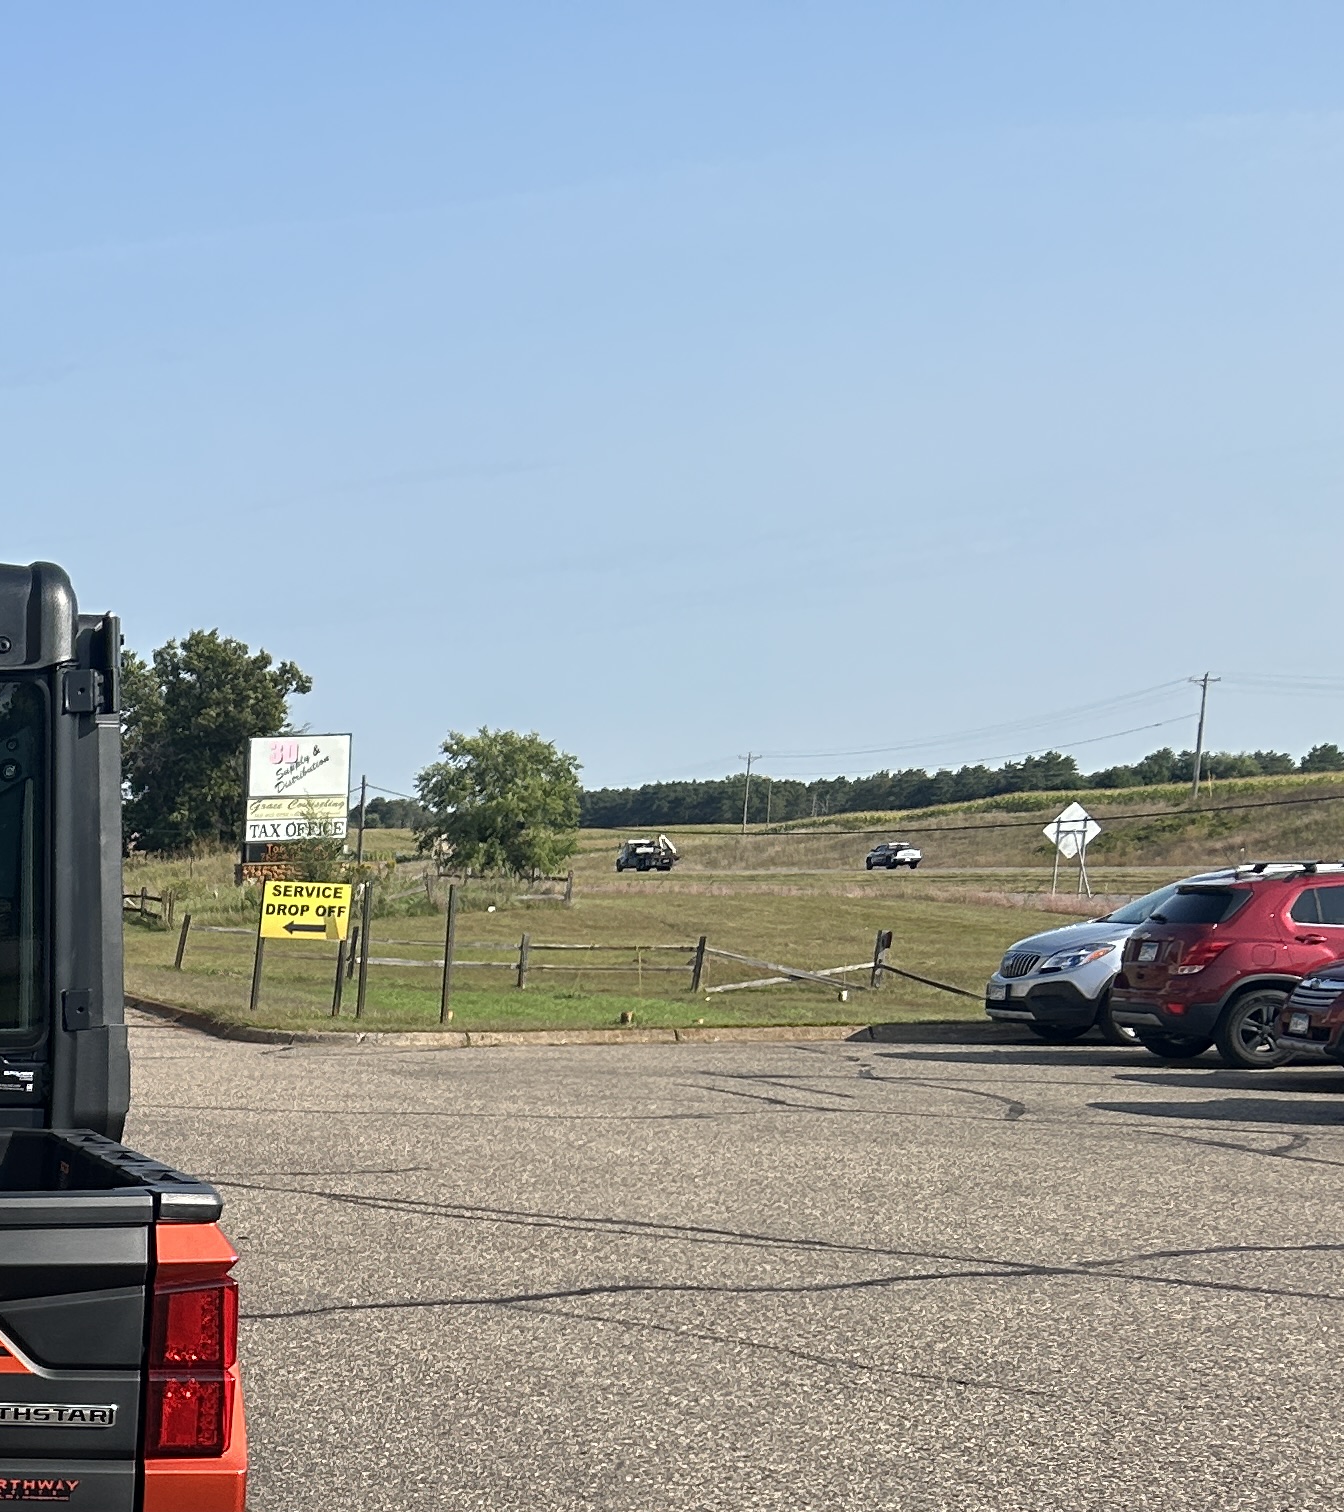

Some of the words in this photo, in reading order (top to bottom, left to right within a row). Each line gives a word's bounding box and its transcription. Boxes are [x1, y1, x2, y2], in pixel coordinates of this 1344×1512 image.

[275, 755, 311, 781] Supply
[313, 745, 320, 756] &
[274, 755, 330, 794] Distribution
[249, 823, 282, 839] TAX
[285, 821, 345, 838] OFFICE
[272, 885, 344, 899] SERVICE
[265, 903, 310, 917] DROP
[315, 904, 347, 918] OFF
